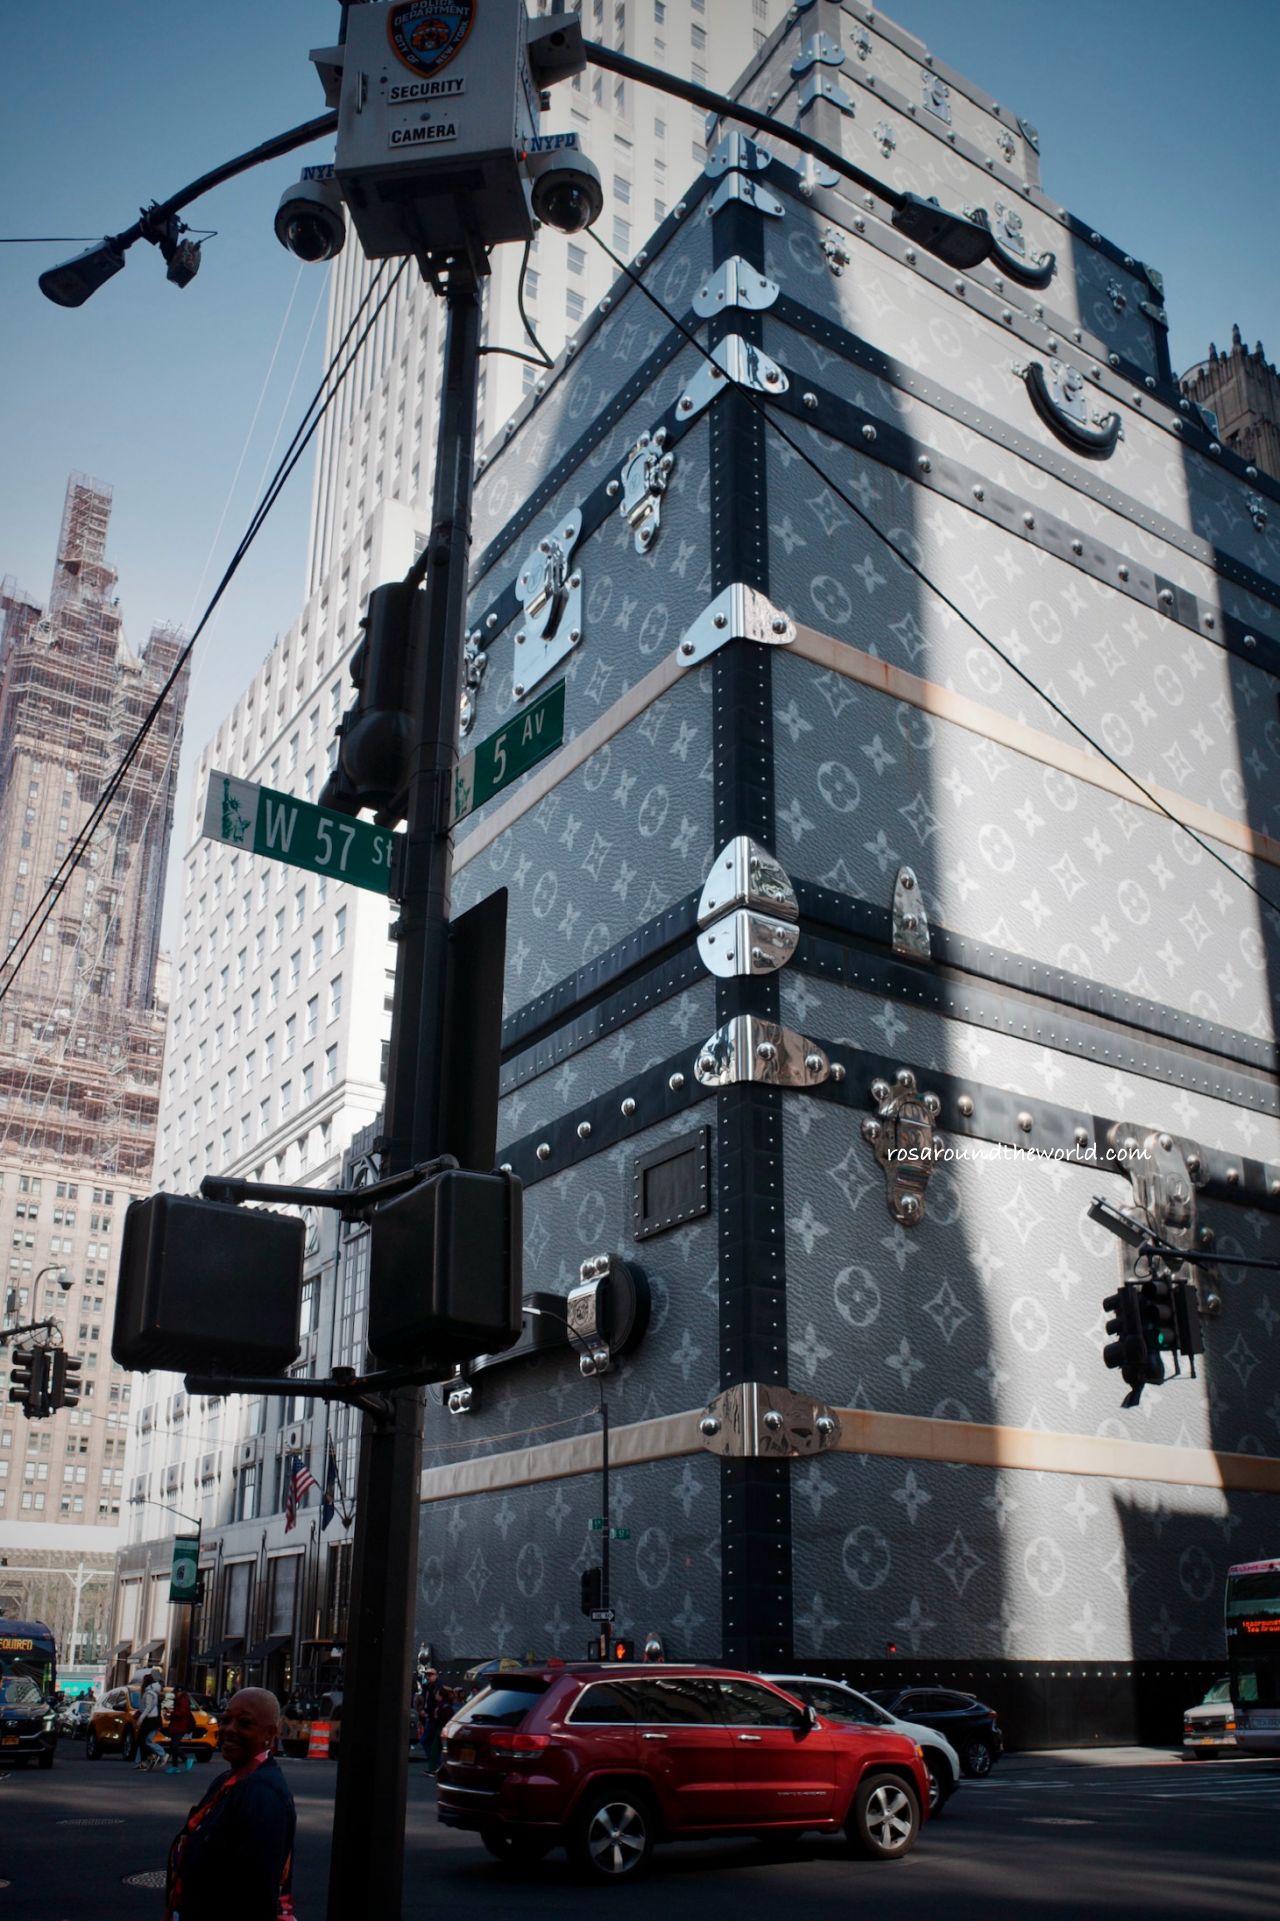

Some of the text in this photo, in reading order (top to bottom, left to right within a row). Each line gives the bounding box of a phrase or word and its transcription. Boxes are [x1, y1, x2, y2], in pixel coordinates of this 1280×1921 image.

[394, 6, 470, 27] DEPARTMENT
[394, 33, 420, 65] CITY OF
[435, 20, 470, 65] NEW YORK
[390, 78, 465, 100] SECURITY
[391, 123, 456, 144] CAMERA
[531, 132, 577, 152] NYPD
[303, 164, 335, 181] NYP
[493, 708, 546, 785] 5 Av
[265, 799, 395, 872] W 57 St
